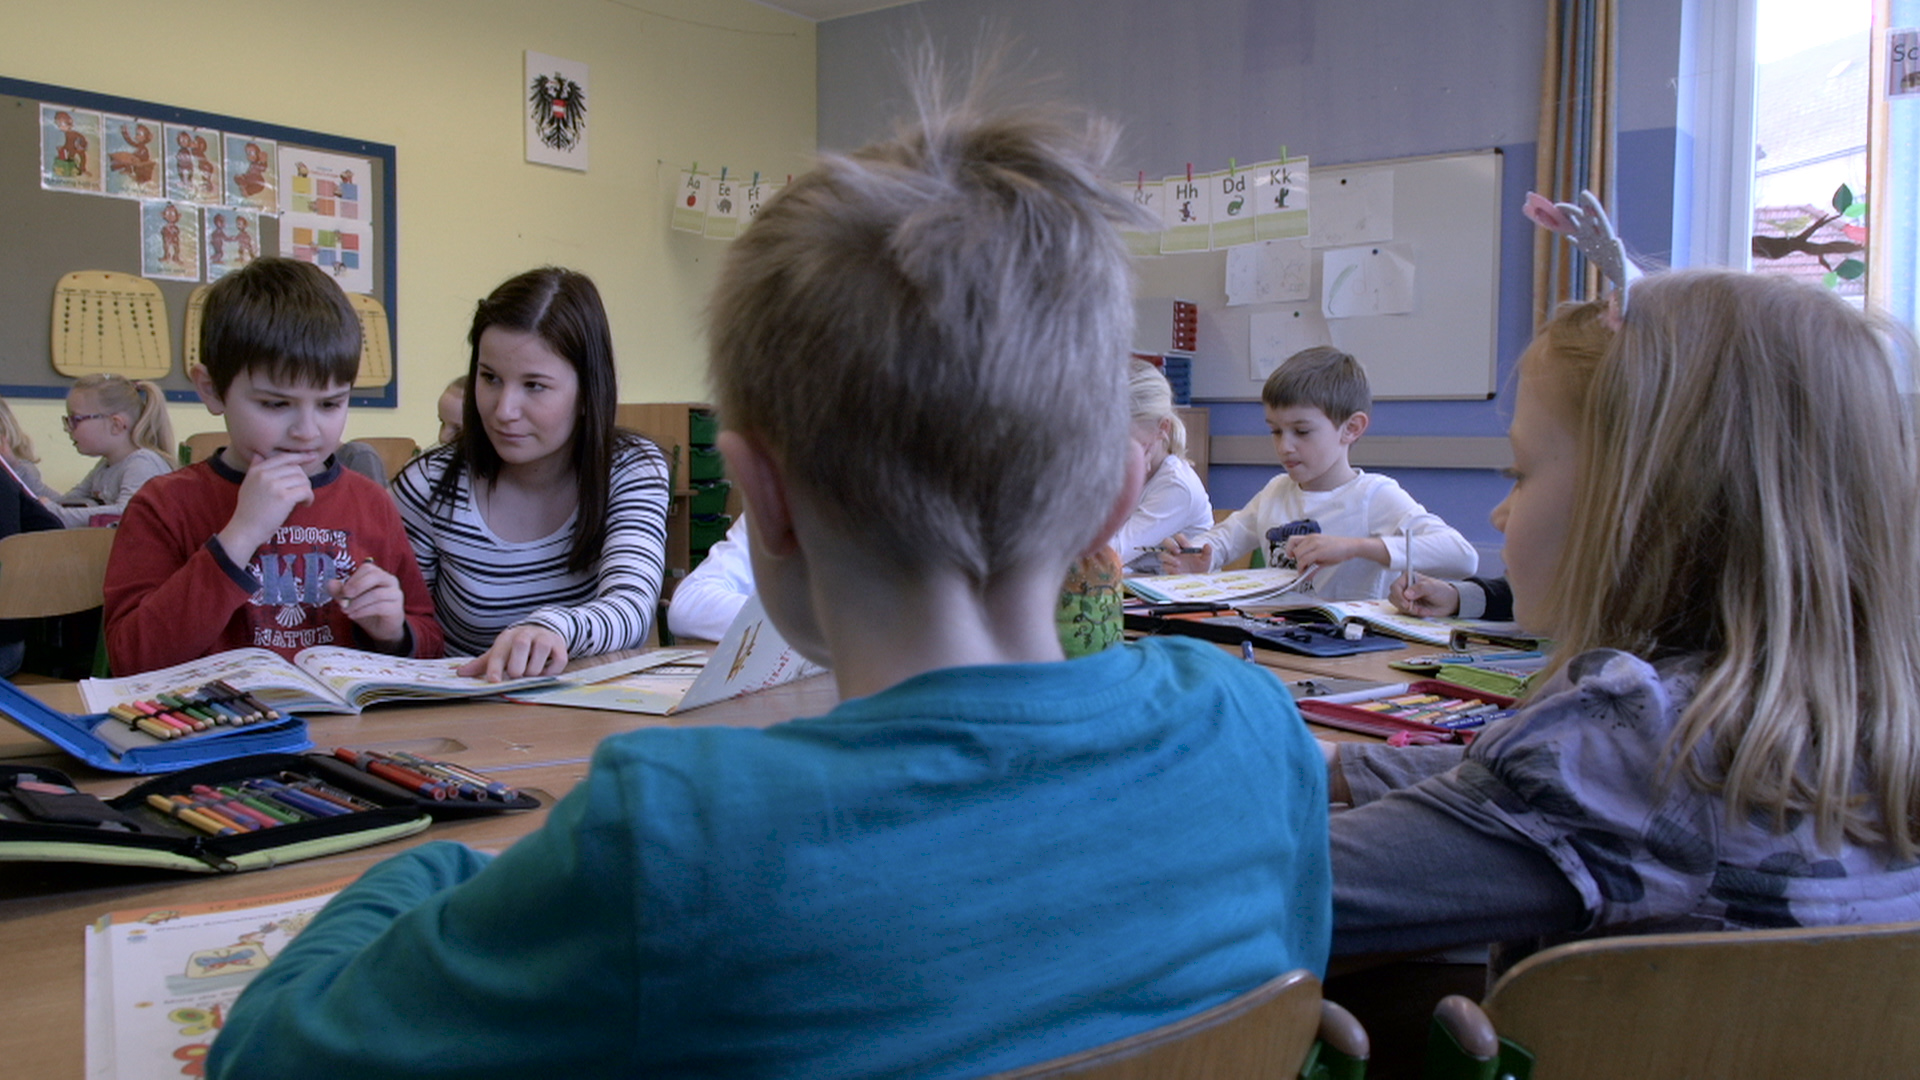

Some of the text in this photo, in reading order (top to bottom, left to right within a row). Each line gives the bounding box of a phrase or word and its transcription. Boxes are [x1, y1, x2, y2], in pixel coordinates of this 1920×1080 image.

[687, 176, 701, 190] Aa
[1222, 175, 1246, 195] Dd
[1269, 168, 1292, 186] Kk
[718, 182, 731, 197] Ee
[748, 187, 760, 201] Ff
[1132, 189, 1153, 206] Rr
[1176, 184, 1199, 200] Hh
[254, 625, 334, 648] NATUR
